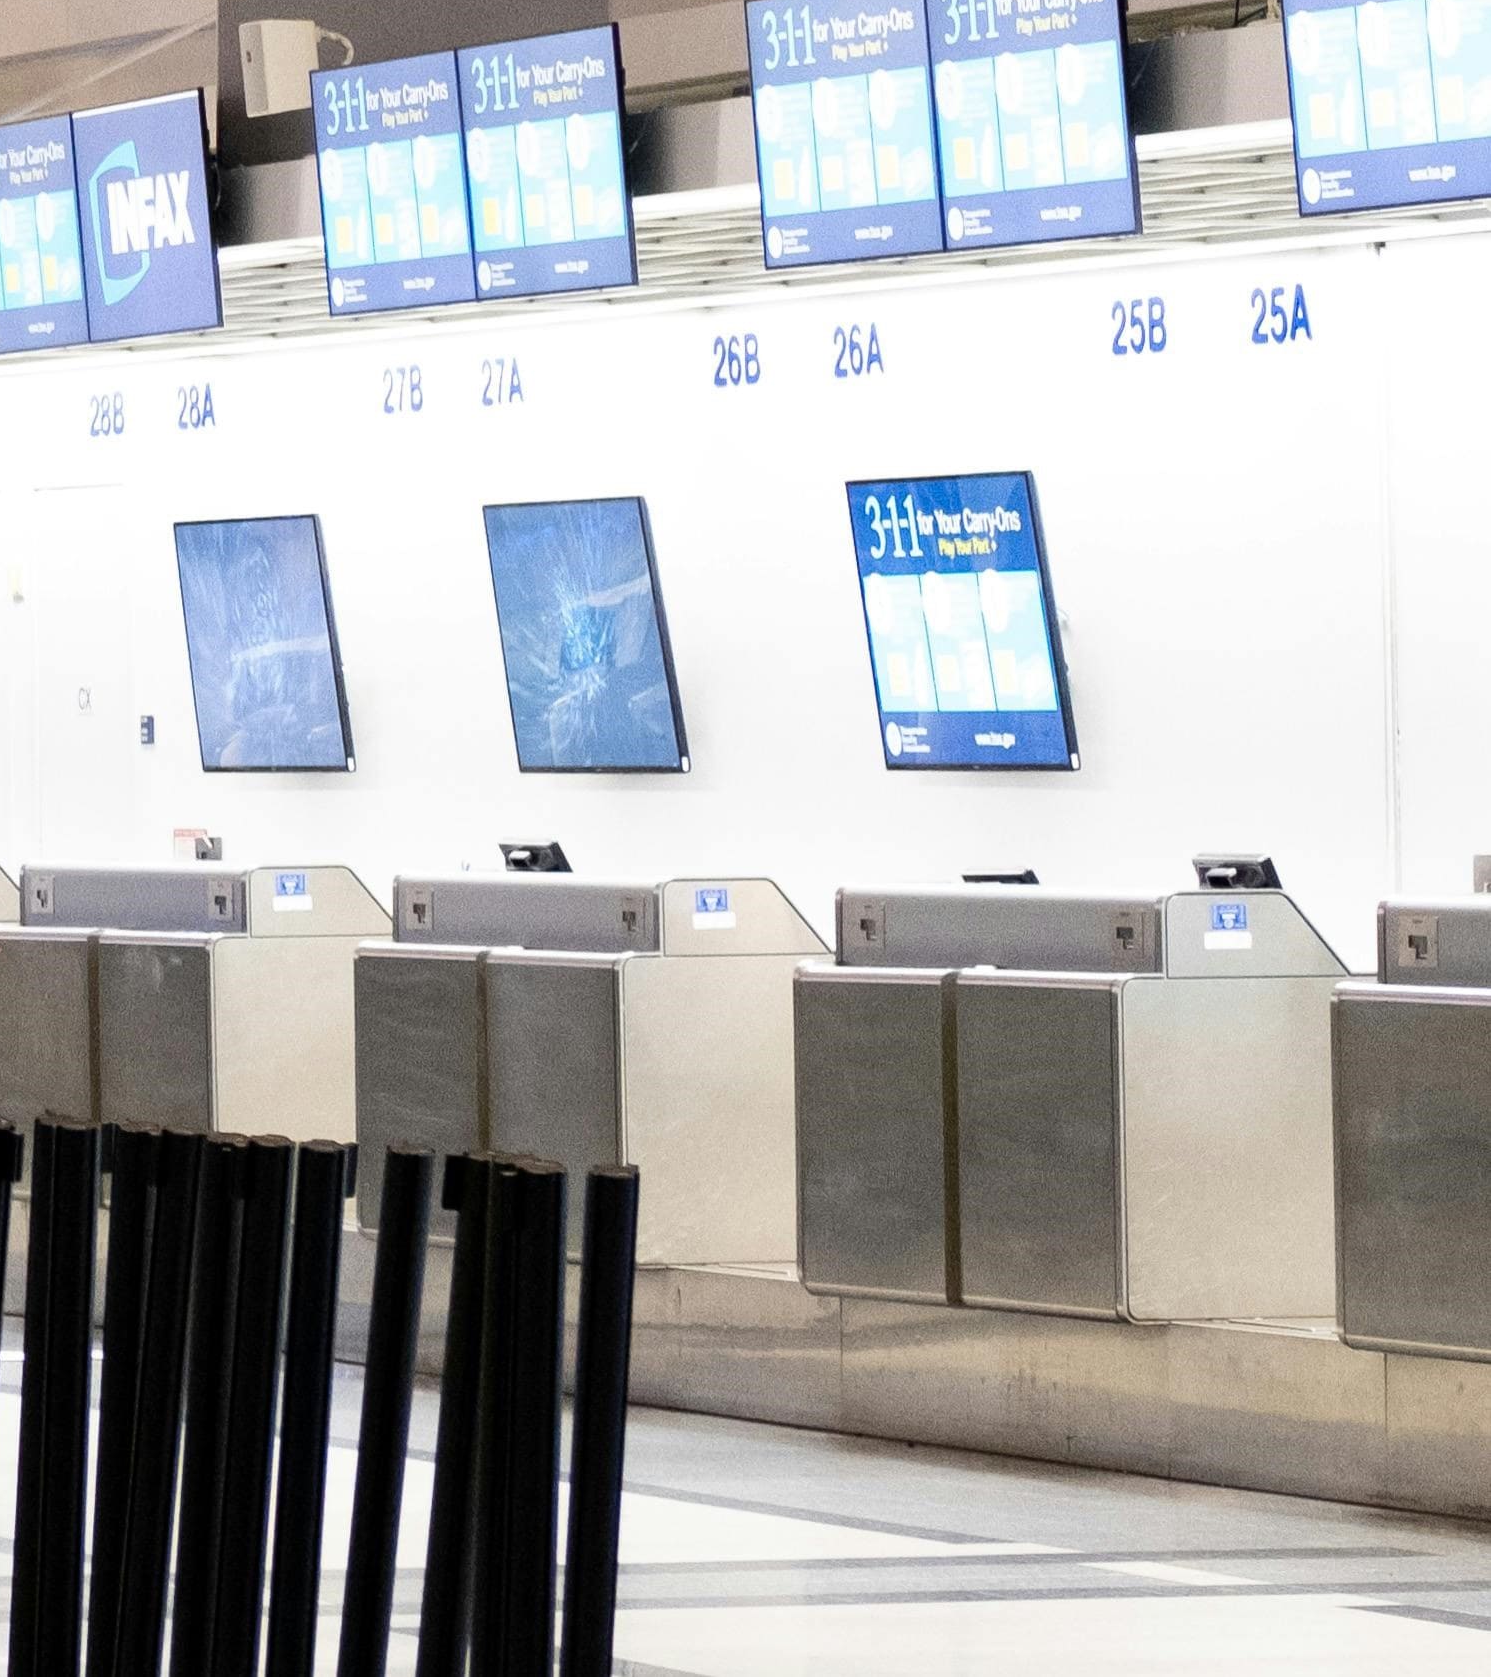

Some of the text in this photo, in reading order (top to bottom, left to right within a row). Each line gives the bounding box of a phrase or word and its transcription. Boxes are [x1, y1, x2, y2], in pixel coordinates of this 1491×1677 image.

[762, 4, 914, 71] 3-1-1 for Your Carry-Ons
[324, 76, 369, 136] 3-1-1
[471, 53, 520, 114] 3-1-1
[107, 170, 195, 255] INFAX
[1111, 296, 1168, 355] 25B
[1250, 284, 1313, 344] 25A
[713, 334, 761, 388] 26B
[833, 323, 884, 378] 26A
[177, 382, 216, 431] 28A
[383, 364, 424, 414] 27B
[481, 357, 524, 406] 27A
[89, 391, 125, 437] 28B
[865, 494, 1021, 559] 3-1-1 for Your Carry-Ons
